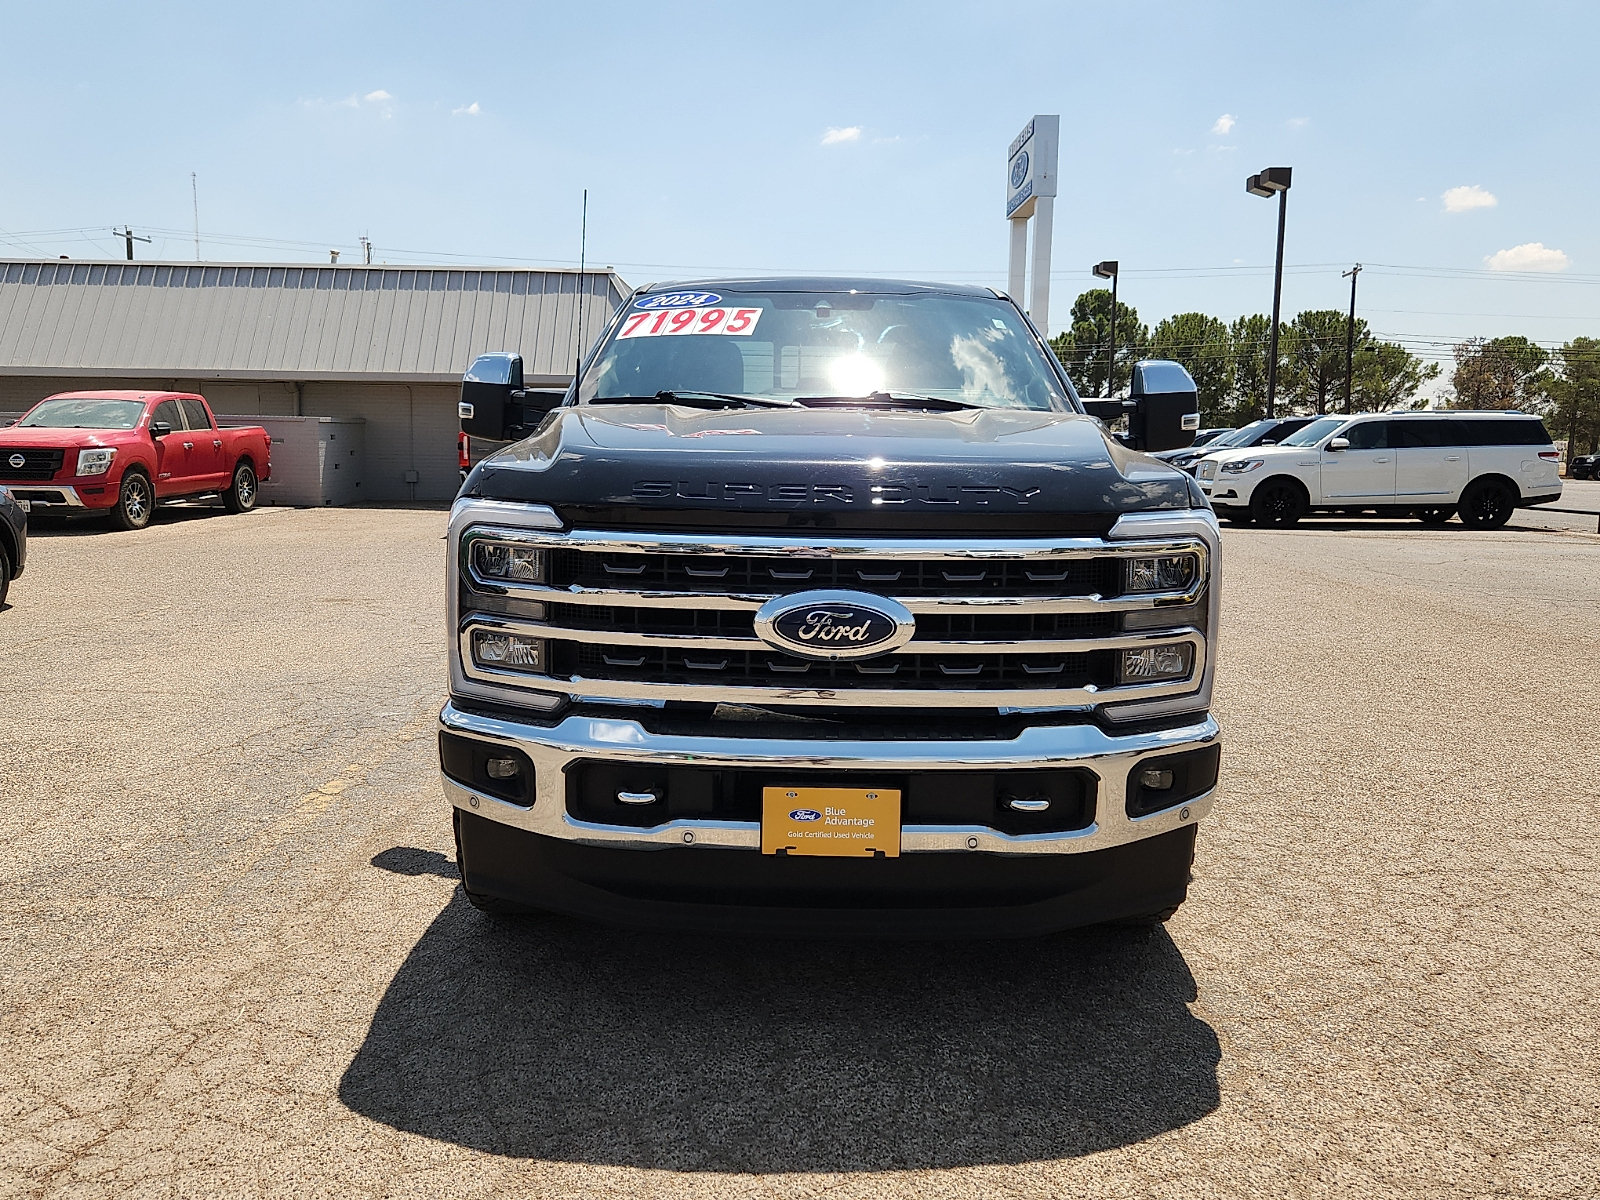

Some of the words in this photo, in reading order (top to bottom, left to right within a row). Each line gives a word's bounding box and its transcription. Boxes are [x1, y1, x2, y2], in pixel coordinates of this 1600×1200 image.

[645, 294, 709, 308] 2024
[621, 308, 758, 337] 71995
[631, 481, 854, 503] SUPER
[870, 484, 1041, 505] DUTY
[797, 610, 872, 641] Ford
[795, 811, 816, 820] Ford
[825, 807, 846, 816] Blue
[825, 817, 875, 827] Advantage
